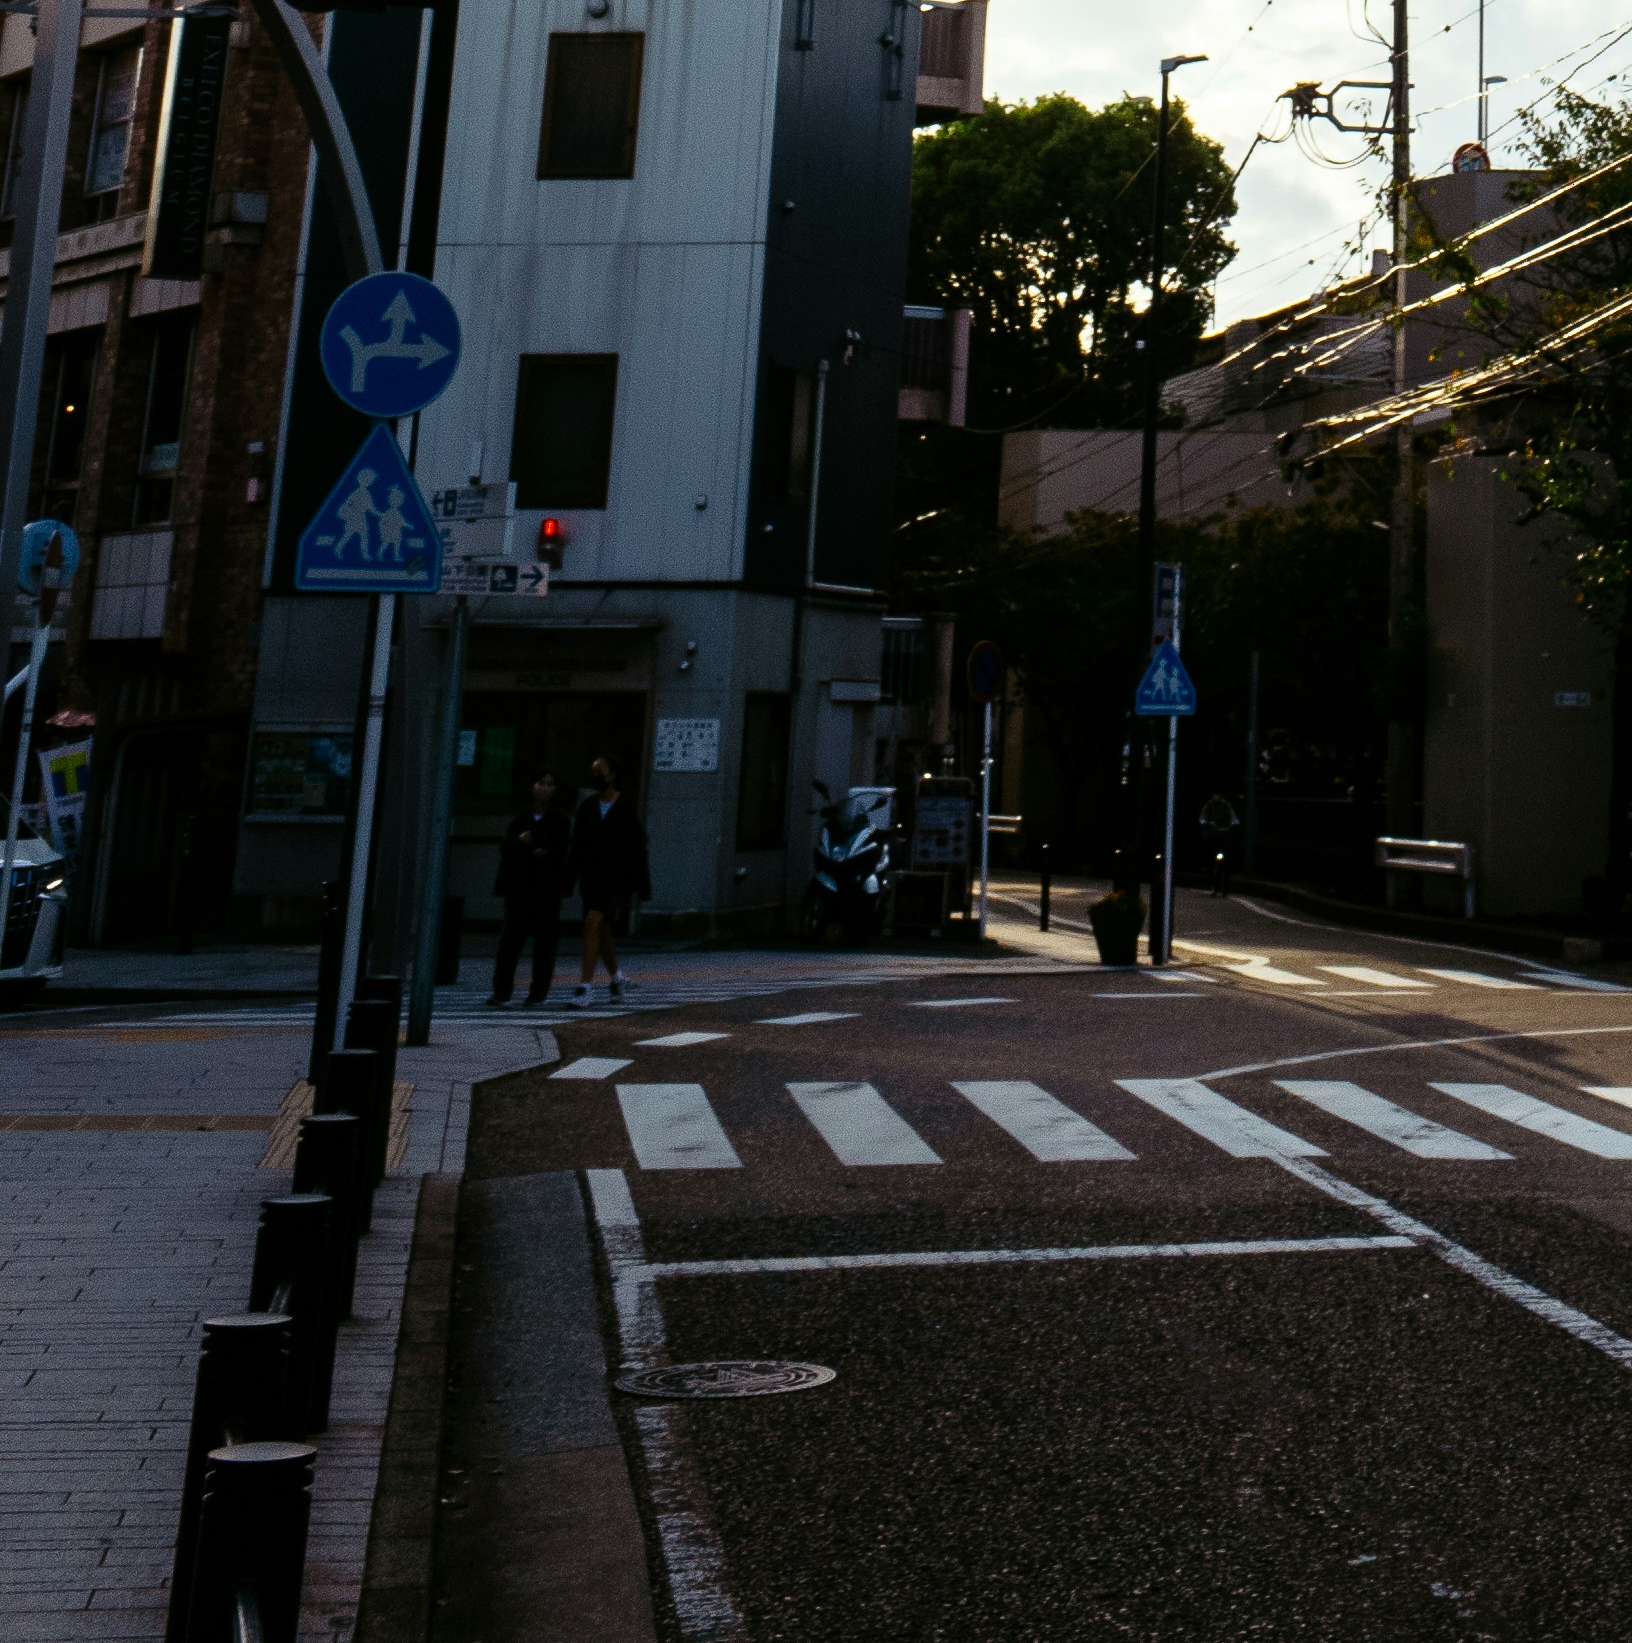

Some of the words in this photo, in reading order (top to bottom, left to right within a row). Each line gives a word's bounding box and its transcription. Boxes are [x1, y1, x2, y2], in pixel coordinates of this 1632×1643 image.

[167, 76, 195, 204] BELGIUM
[197, 32, 226, 126] EXELCO
[180, 131, 212, 256] DIAMOND
